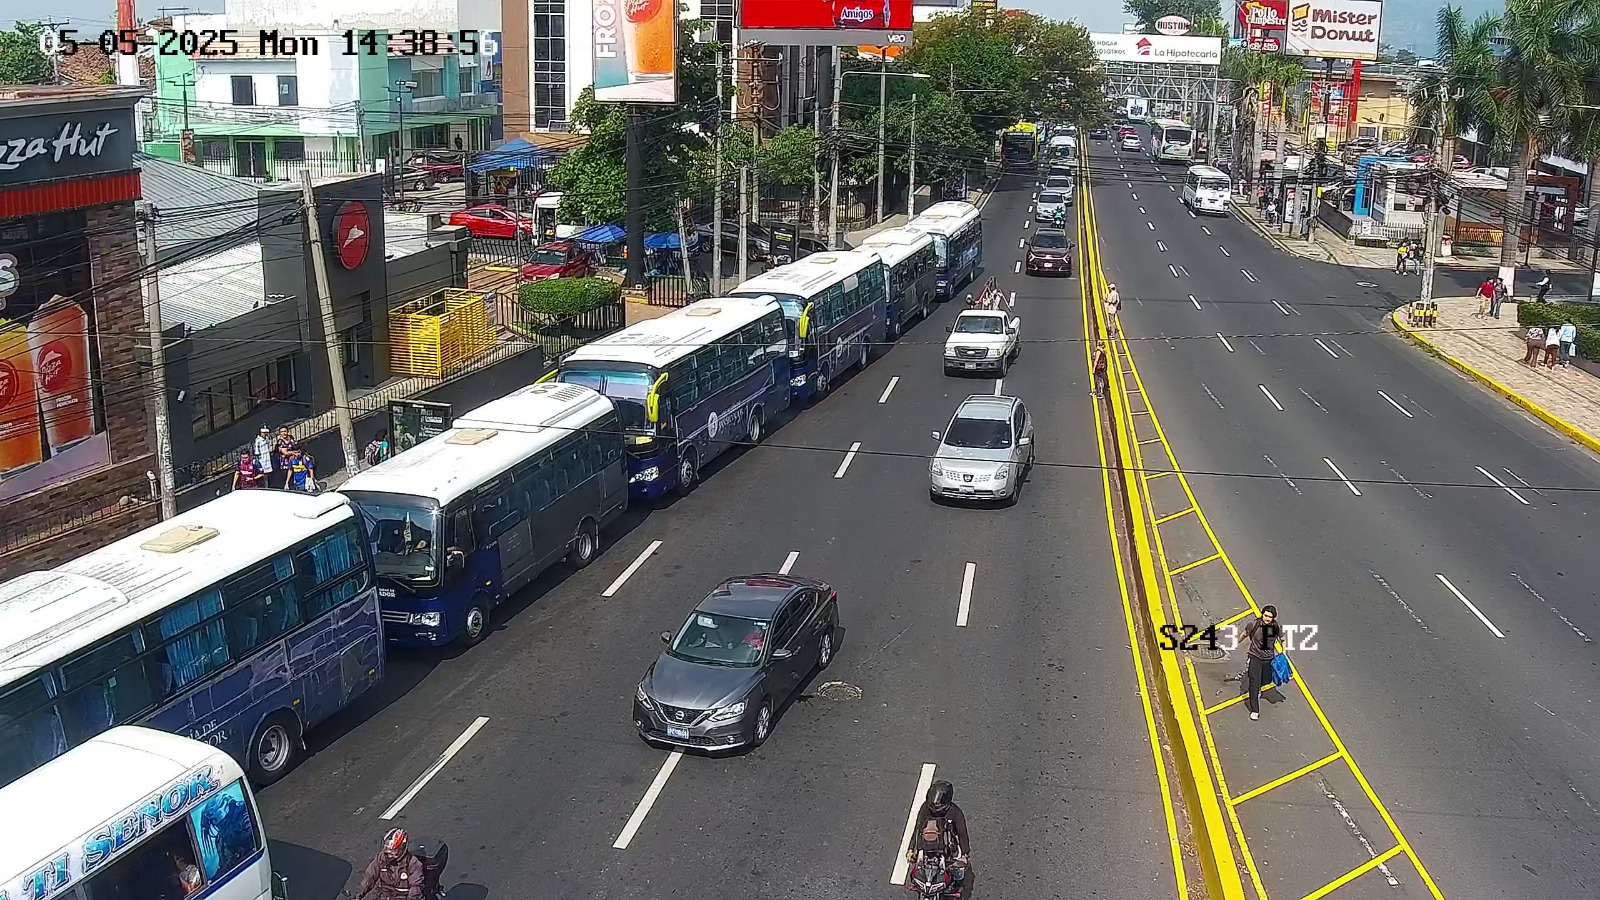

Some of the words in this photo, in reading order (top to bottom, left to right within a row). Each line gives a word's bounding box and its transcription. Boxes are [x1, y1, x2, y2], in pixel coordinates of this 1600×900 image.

[841, 8, 874, 20] Amigos
[1252, 6, 1278, 18] Pollo
[1312, 9, 1377, 25] Mister
[595, 0, 617, 58] FRO
[1311, 26, 1375, 42] Donut
[887, 34, 906, 43] veo
[1154, 48, 1165, 57] La
[52, 122, 119, 162] Hut
